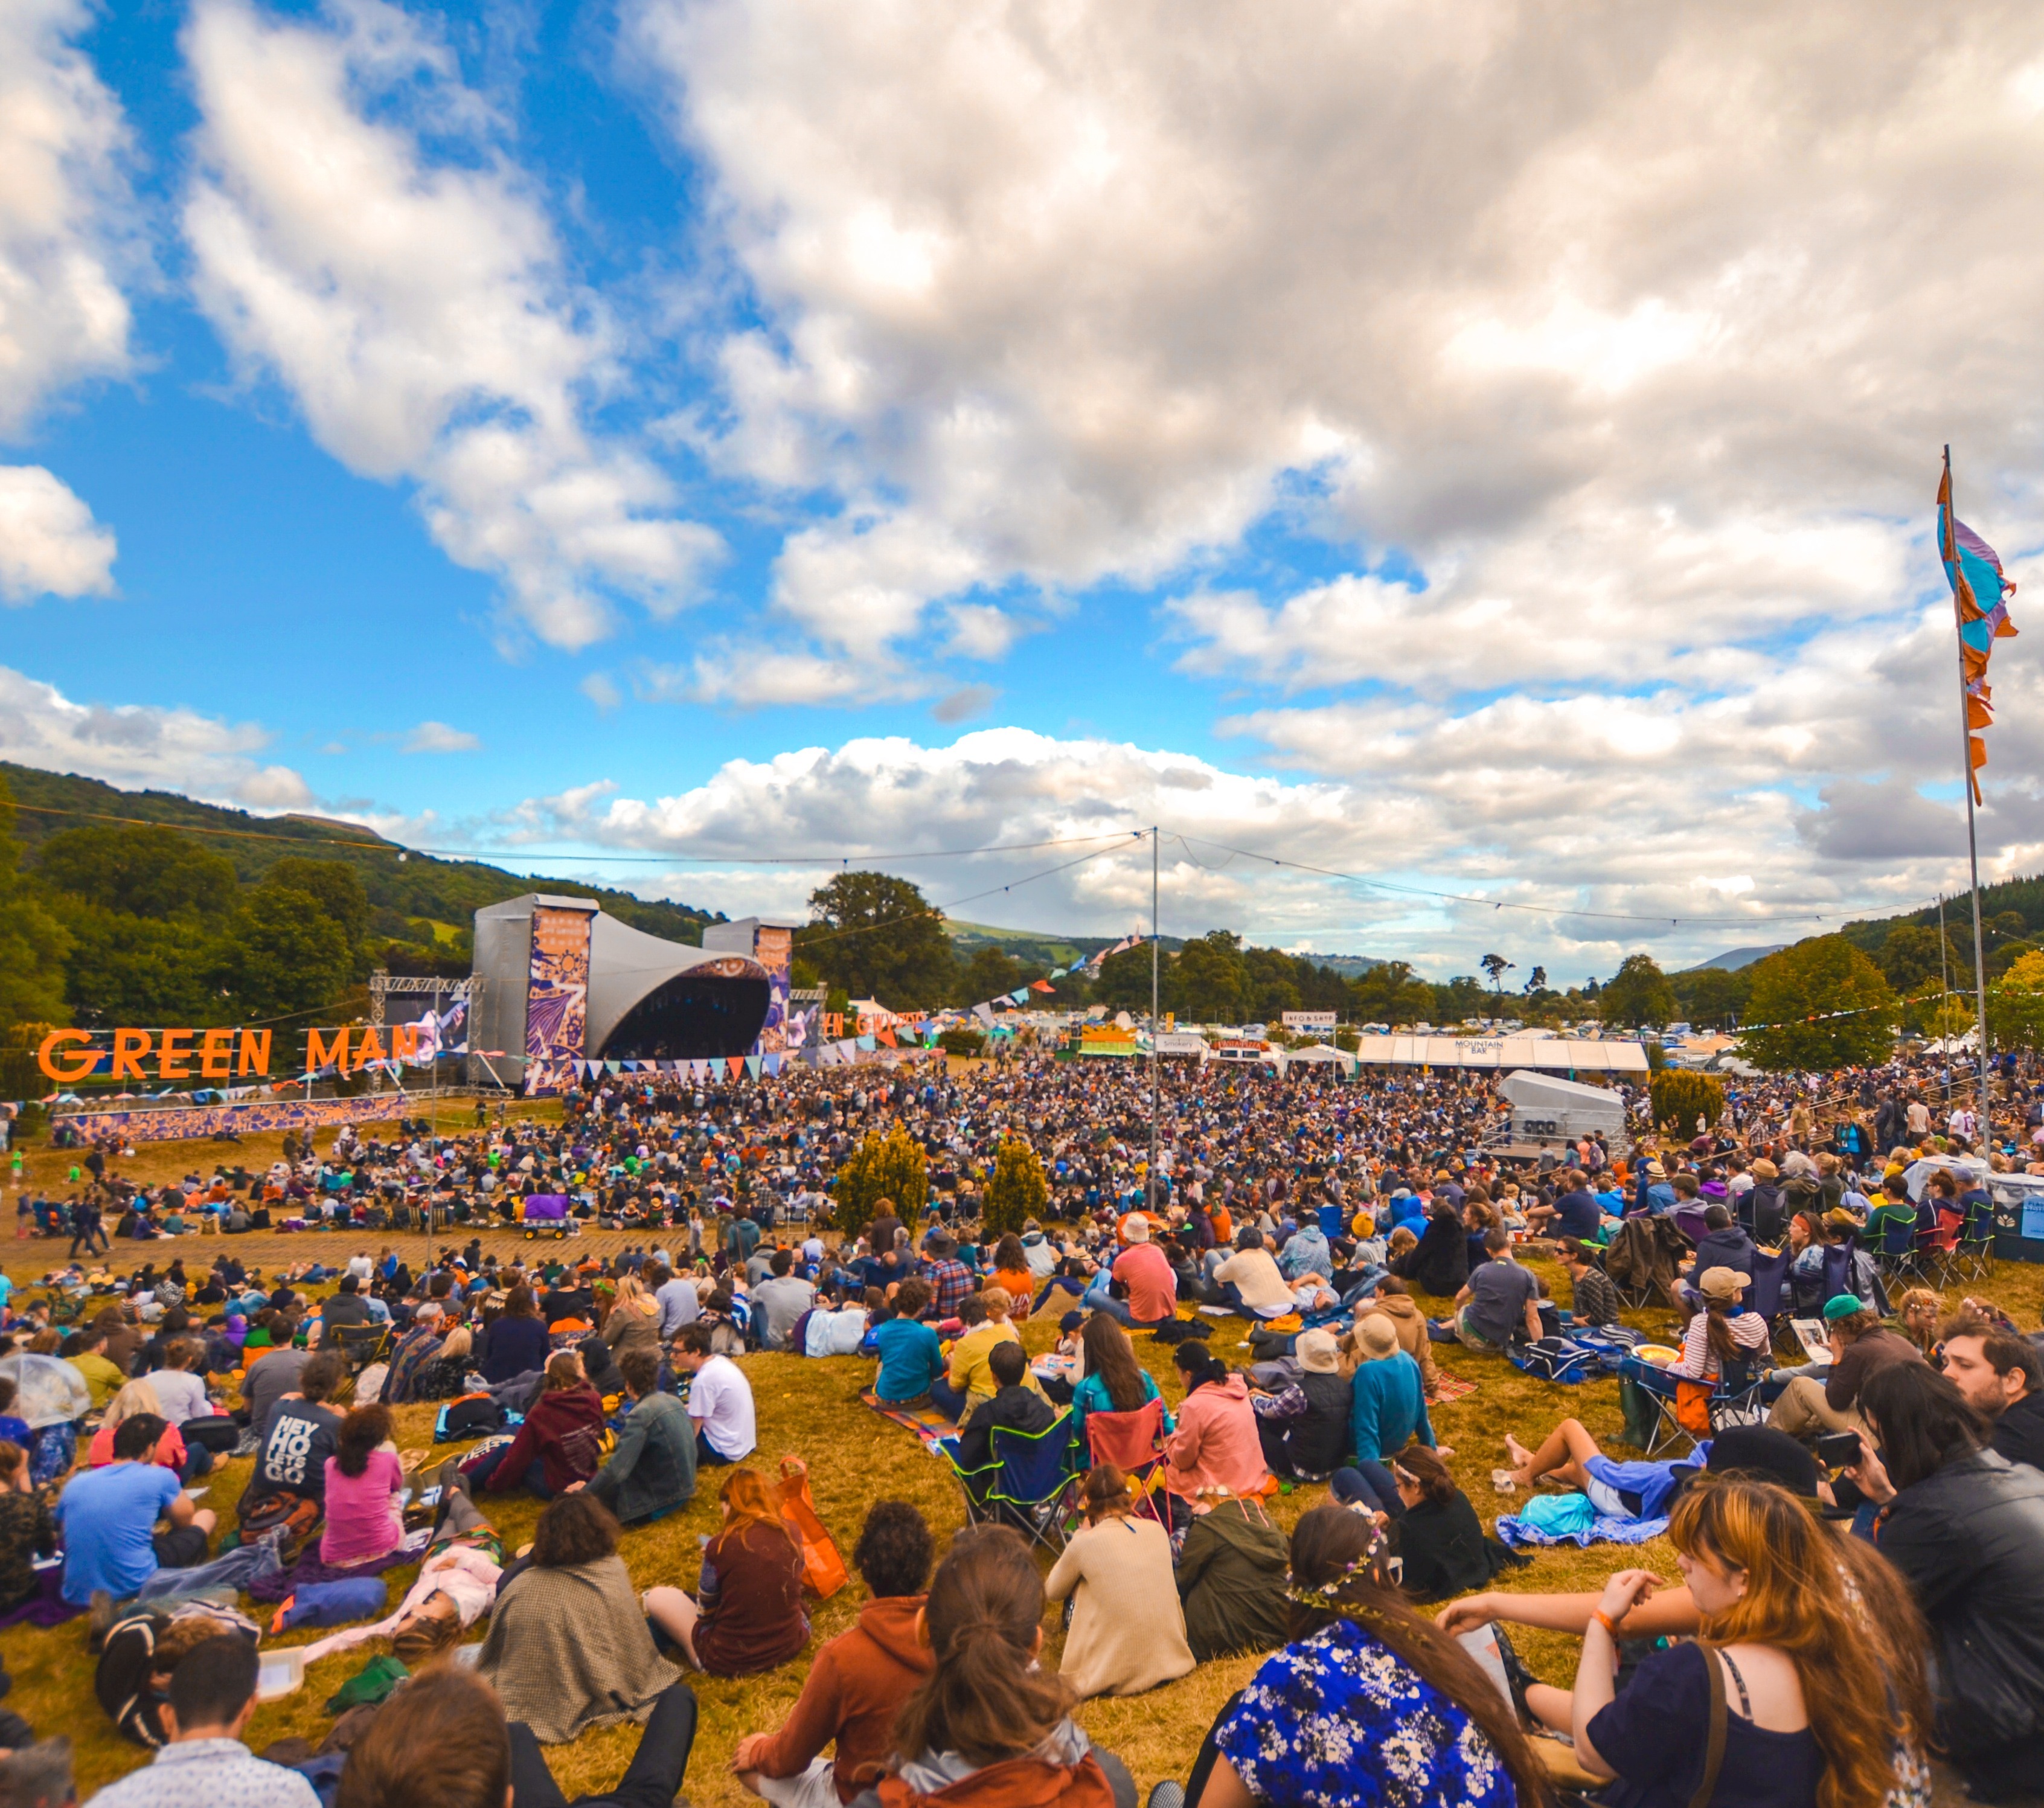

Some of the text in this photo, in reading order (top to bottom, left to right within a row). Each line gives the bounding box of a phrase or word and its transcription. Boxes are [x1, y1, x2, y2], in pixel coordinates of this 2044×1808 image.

[1164, 1037, 1193, 1048] Smokery
[1455, 1040, 1504, 1048] MOUNTAIN
[1472, 1046, 1487, 1054] BAR
[38, 1025, 418, 1082] GREEN MAN
[278, 1415, 319, 1437] HEY
[268, 1430, 311, 1457] HO
[266, 1450, 306, 1469] LETS
[265, 1462, 305, 1484] GO
